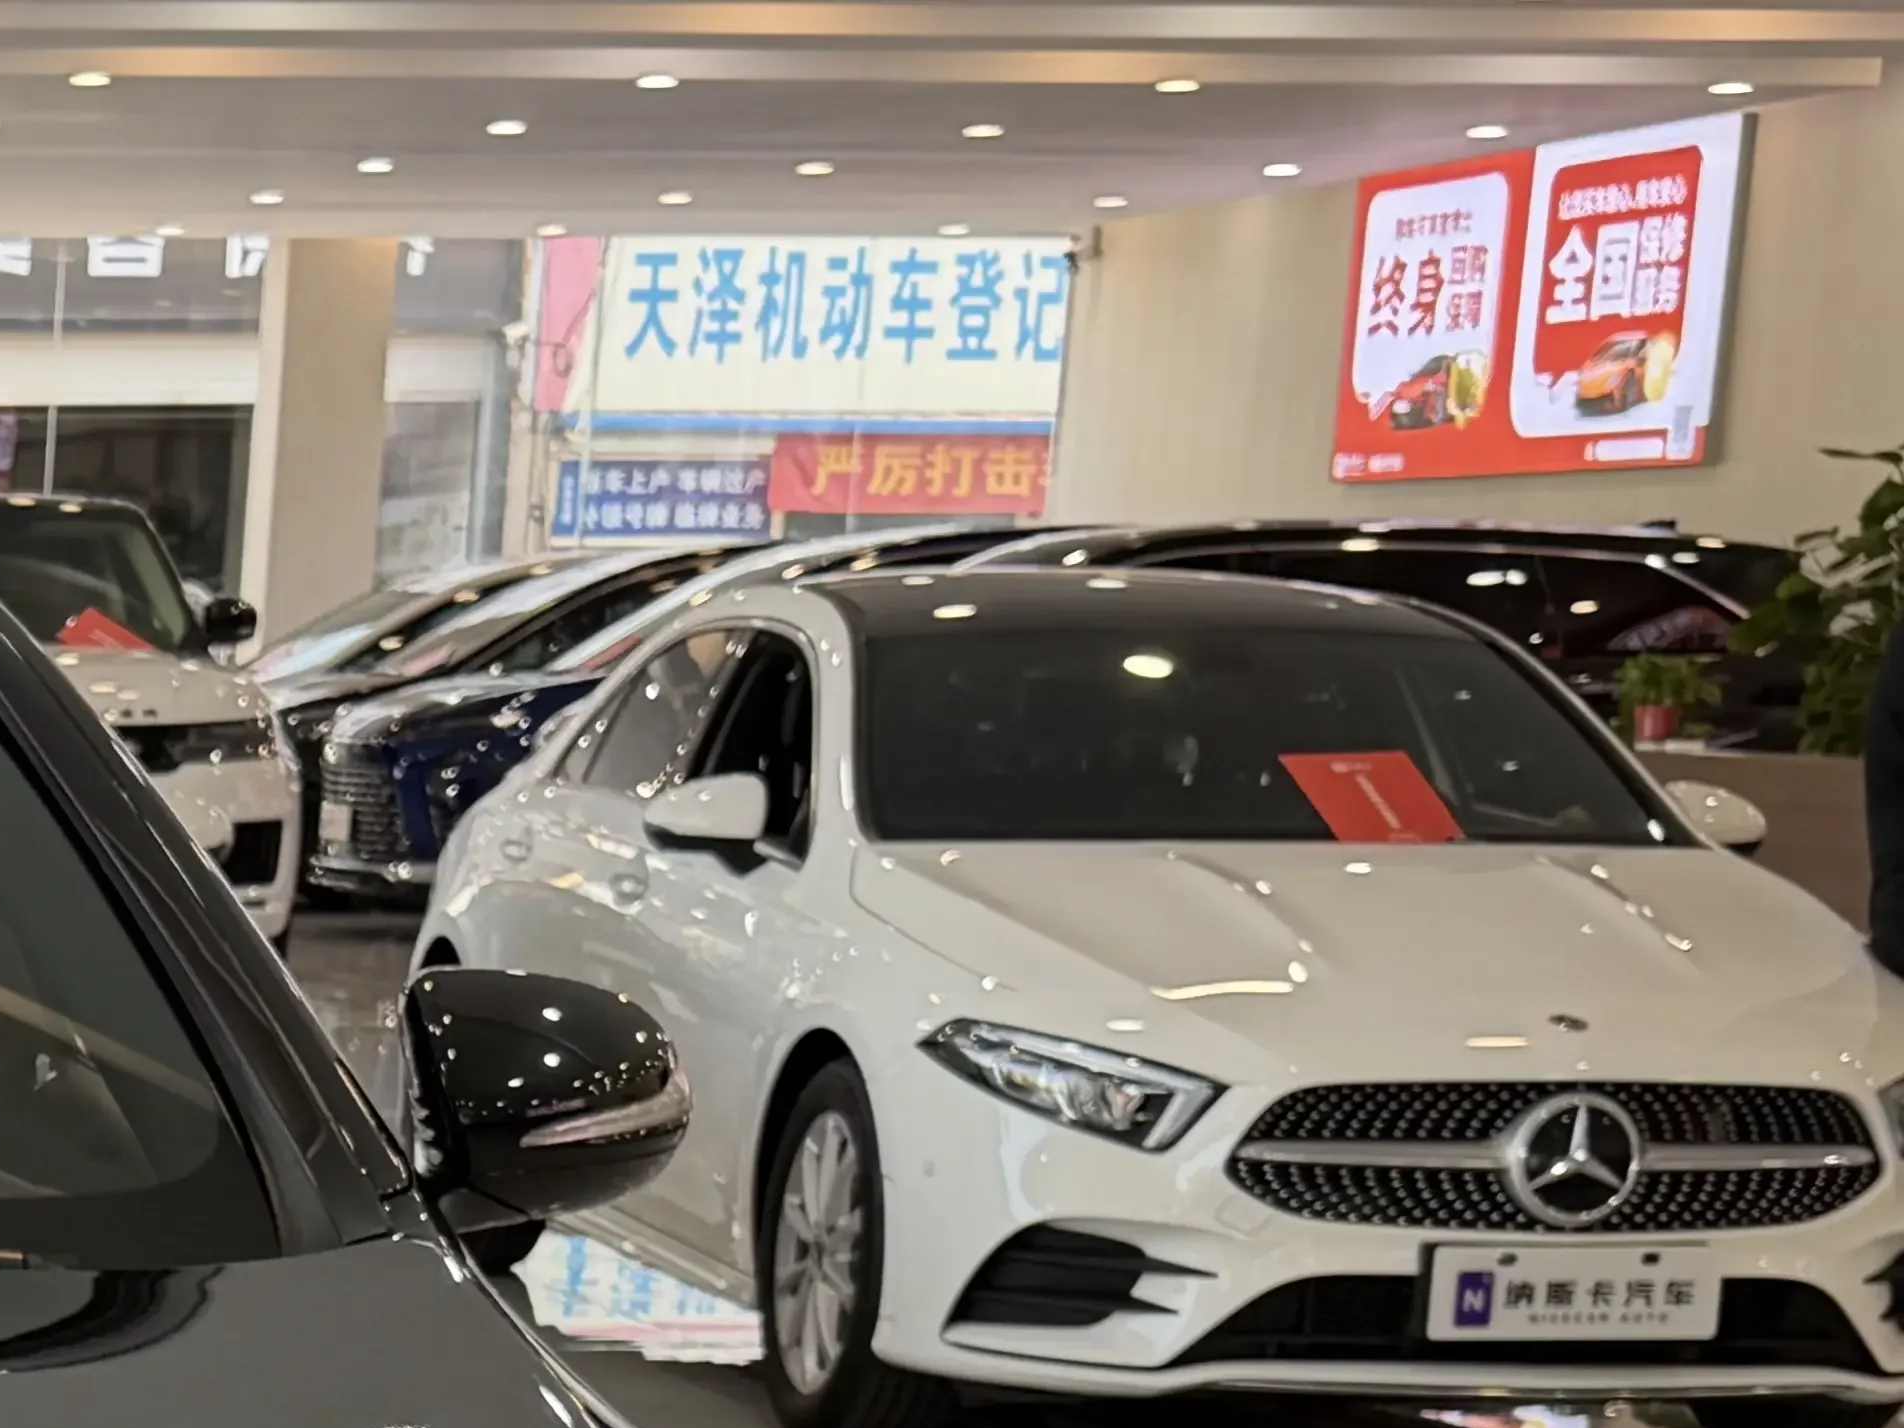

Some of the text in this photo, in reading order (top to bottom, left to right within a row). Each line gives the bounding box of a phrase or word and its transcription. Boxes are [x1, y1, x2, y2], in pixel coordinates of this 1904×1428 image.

[624, 246, 1068, 364] 天泽机动车登记
[1367, 249, 1444, 336] 终身
[1545, 221, 1639, 323] 全国
[810, 444, 1051, 497] 严厉打击
